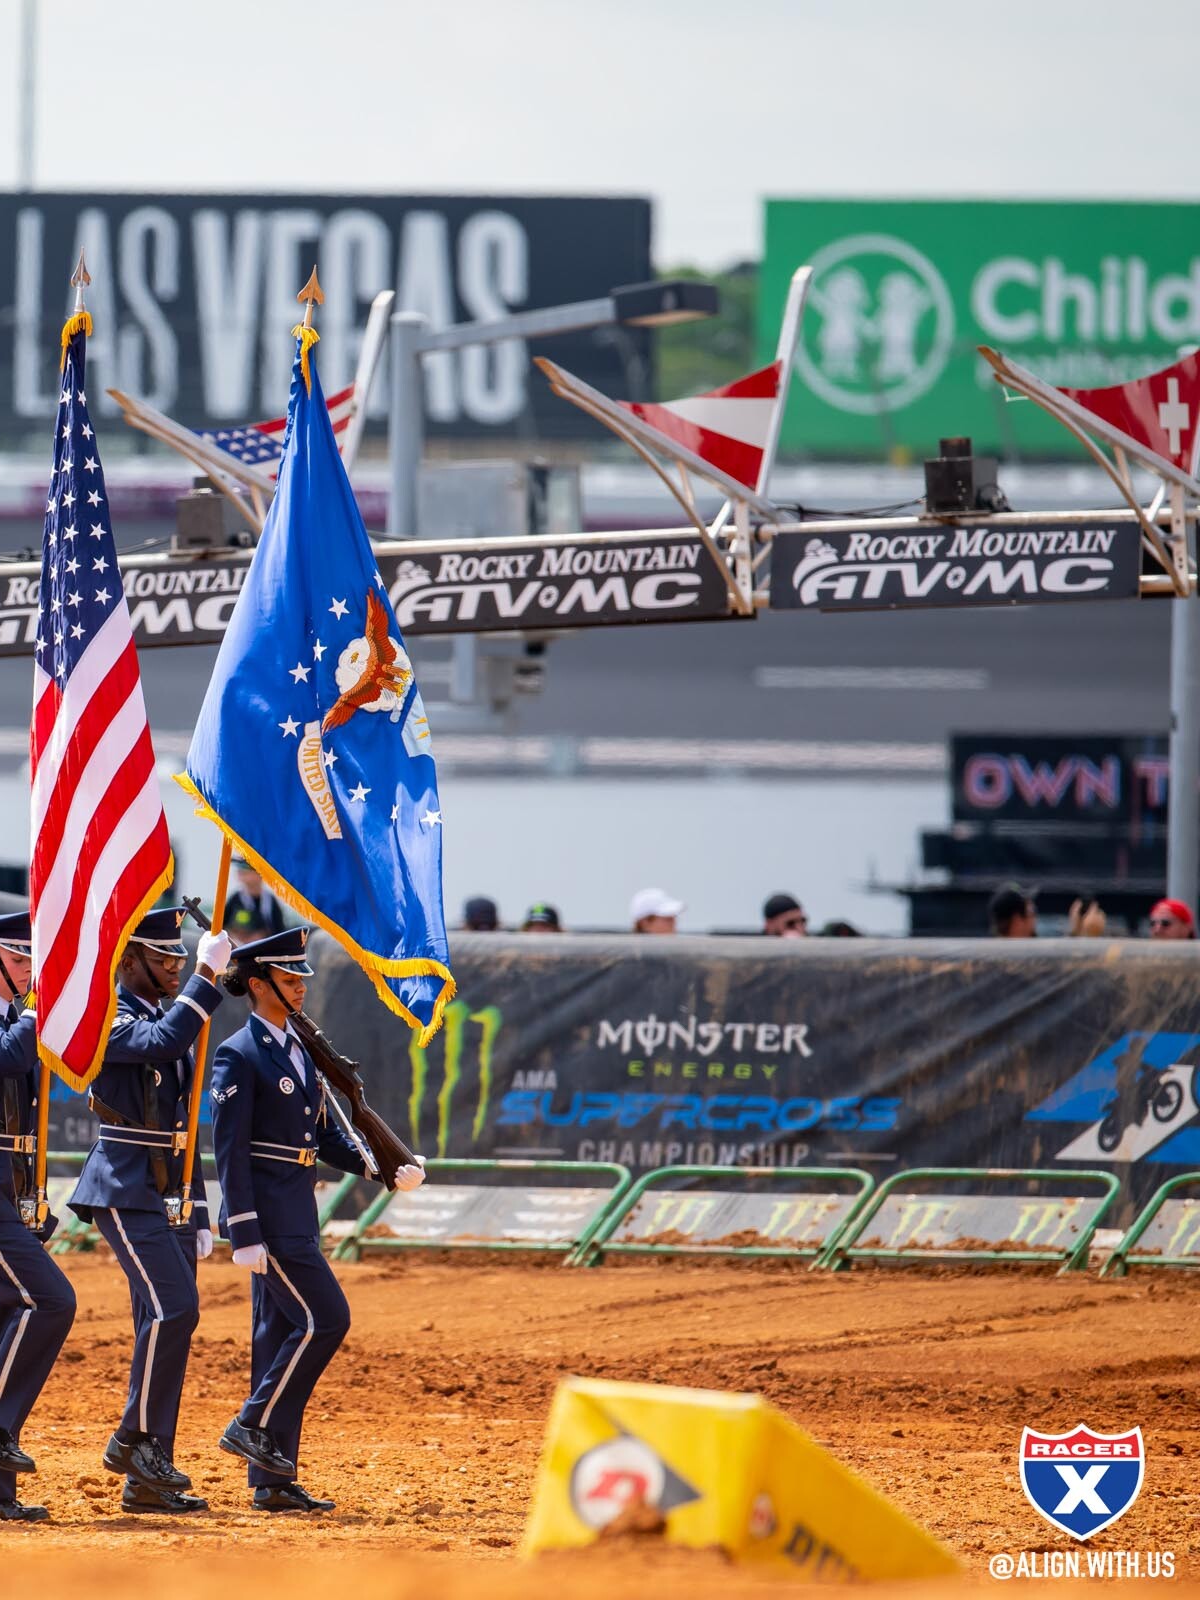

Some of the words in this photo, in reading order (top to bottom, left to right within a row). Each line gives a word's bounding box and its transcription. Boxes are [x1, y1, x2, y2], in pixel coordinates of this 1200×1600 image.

[15, 205, 179, 418] LAS
[190, 207, 529, 424] VEGAS
[970, 254, 1200, 342] Child
[435, 553, 534, 583] ROCKY
[536, 543, 702, 577] MOUNTAIN
[842, 533, 945, 562] ROCKY
[946, 528, 1117, 559] MOUNTAIN
[303, 737, 326, 792] UNITED
[963, 752, 1121, 809] OWN
[597, 1013, 813, 1058] MONSTER
[511, 1069, 558, 1090] AMA
[628, 1059, 781, 1081] ENERGY
[495, 1090, 904, 1132] SUPERCROSS
[577, 1138, 810, 1169] CHAMPIONSHIP
